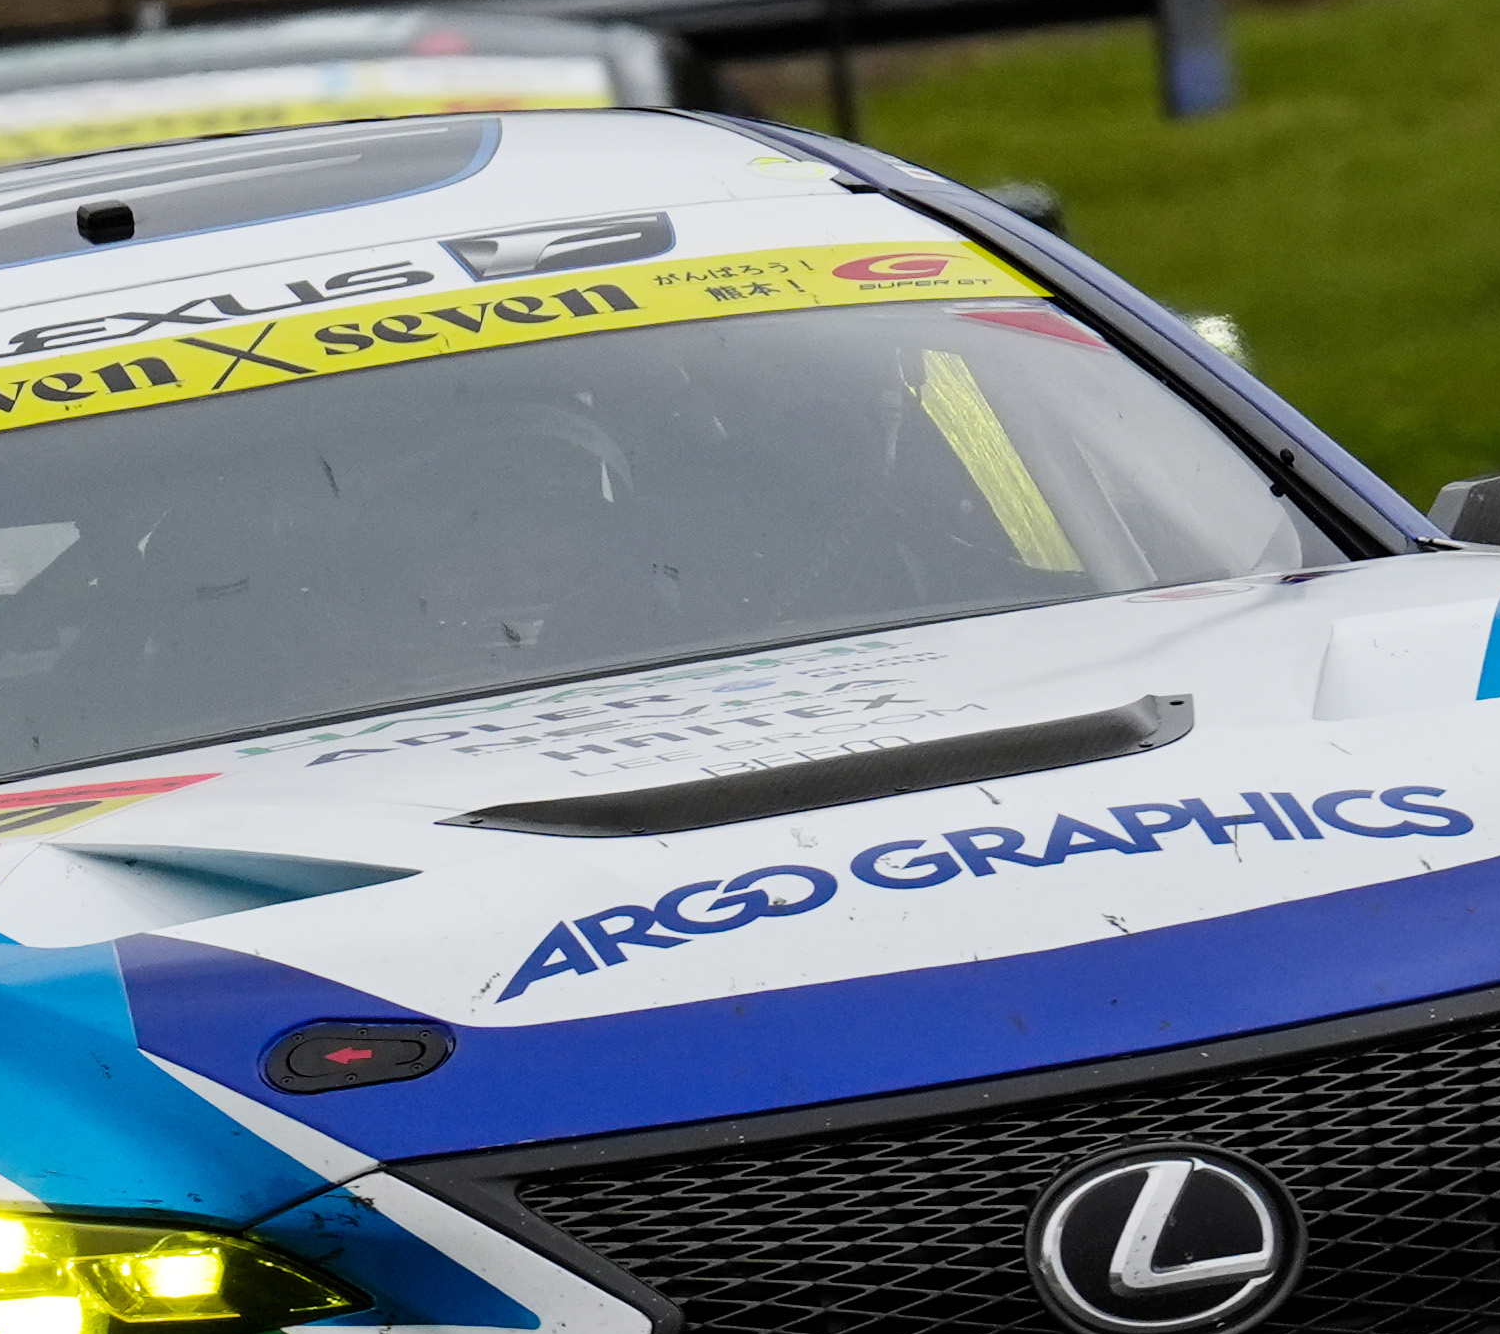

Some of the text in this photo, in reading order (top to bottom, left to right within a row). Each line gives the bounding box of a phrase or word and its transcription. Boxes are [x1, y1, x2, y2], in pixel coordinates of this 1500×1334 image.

[314, 282, 645, 357] seven
[859, 277, 994, 291] SUPER GT
[304, 692, 687, 768] ADLER
[450, 677, 906, 754] NEVHA
[539, 692, 928, 765] HAITEX
[570, 702, 989, 778] LEE BROOM
[494, 785, 1475, 1005] ARGO GRAPHICS
